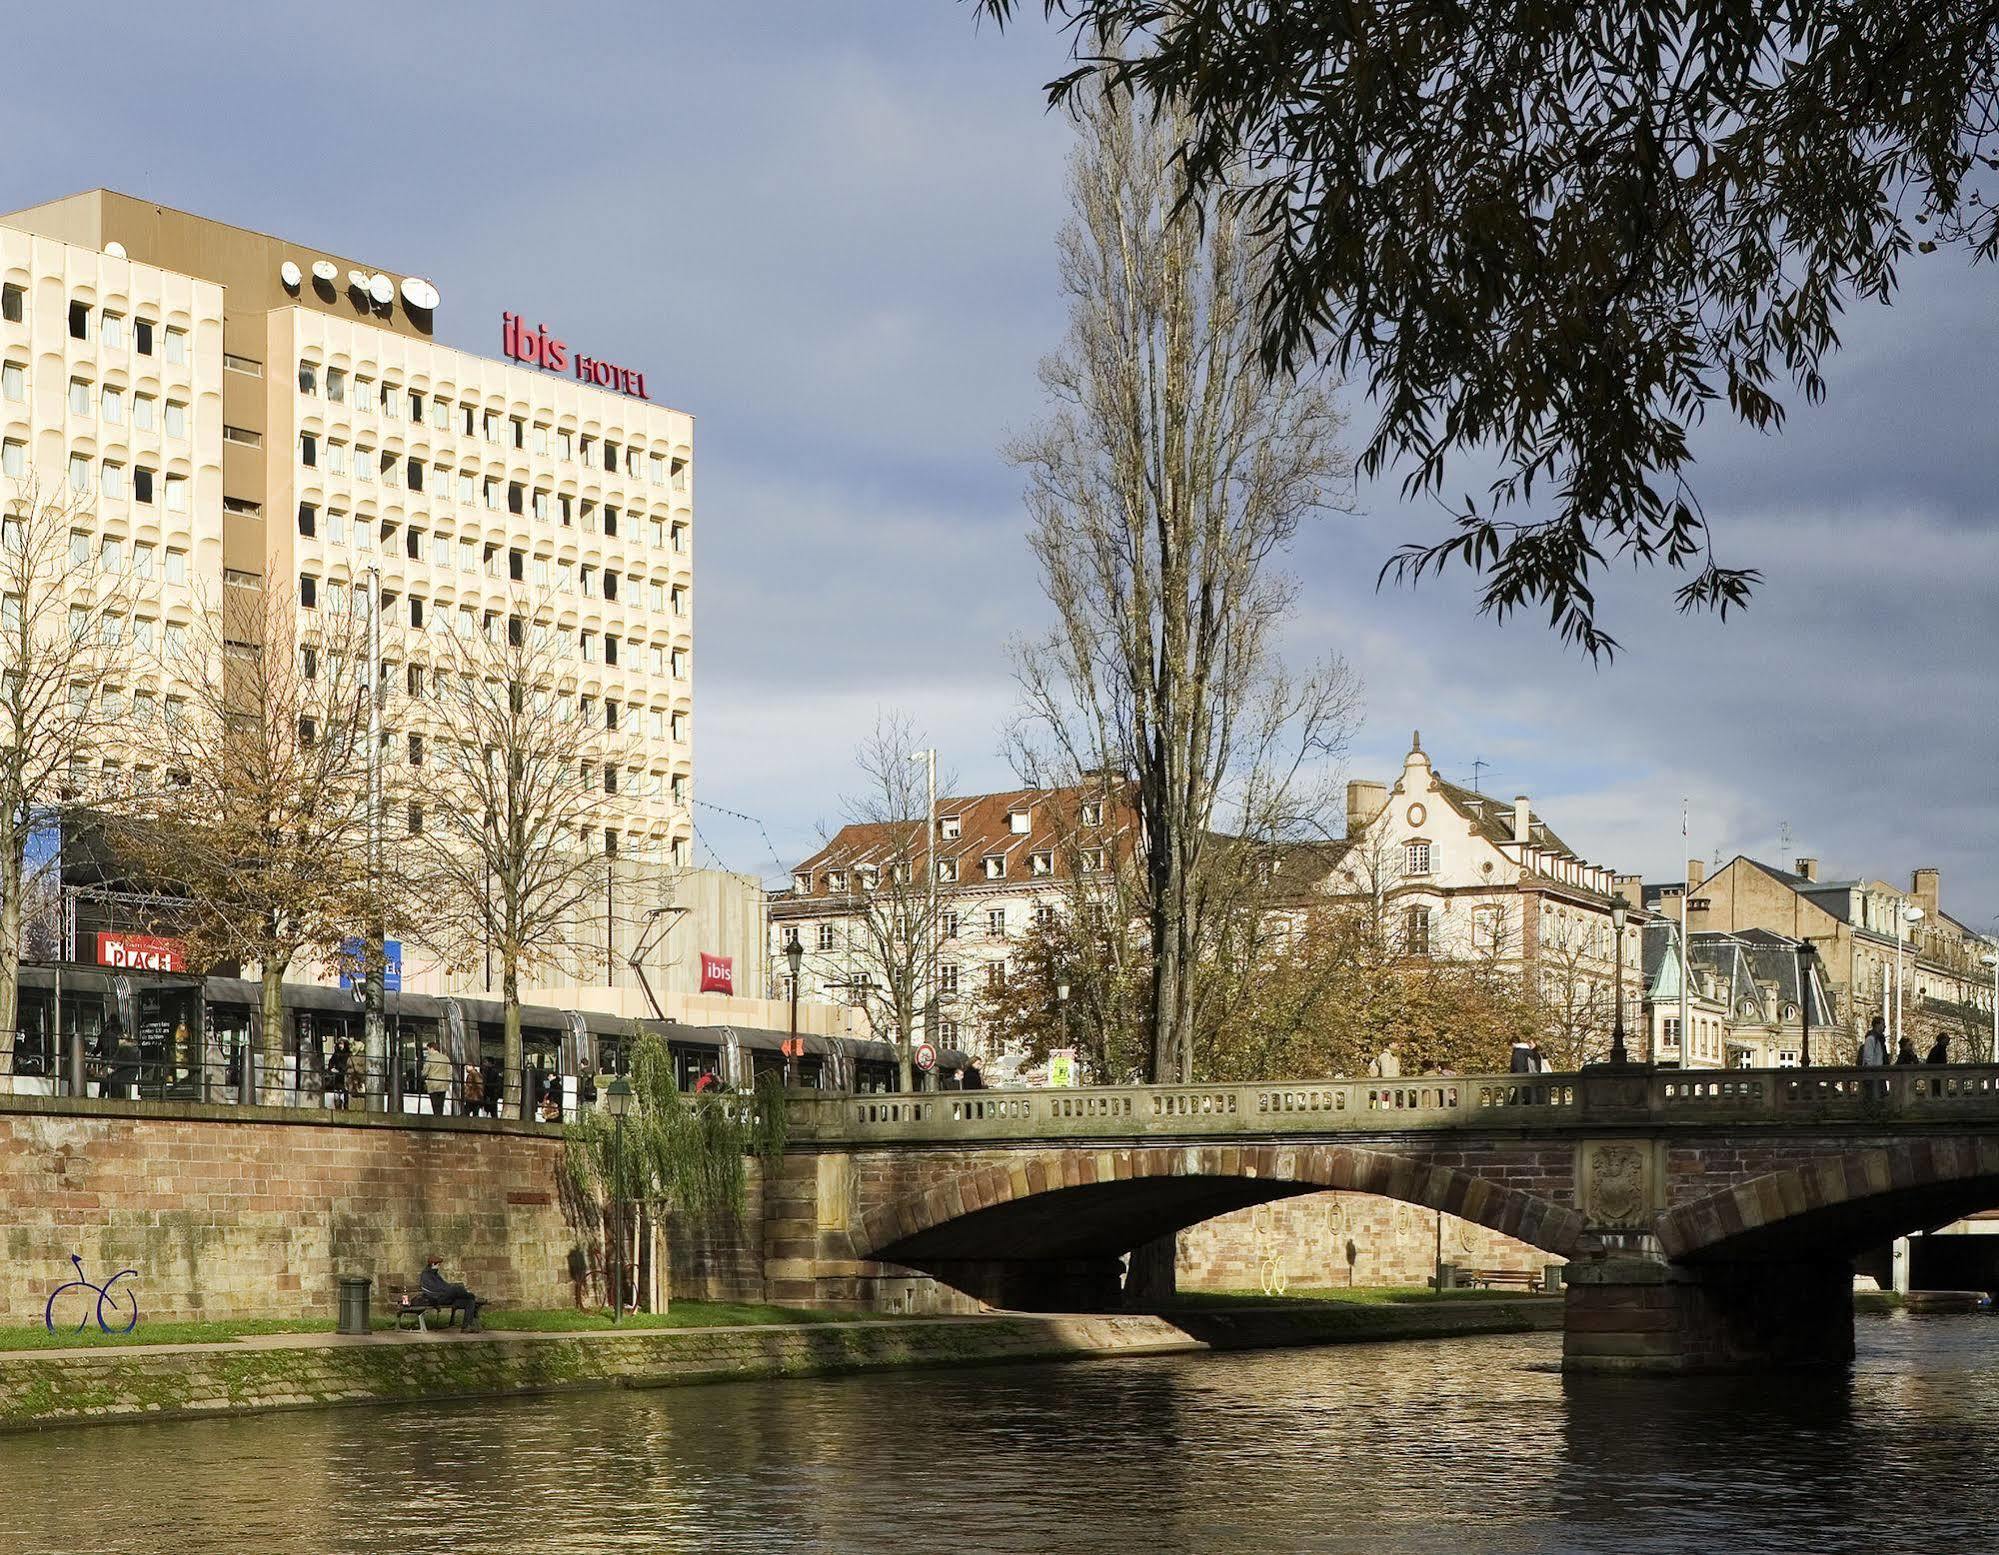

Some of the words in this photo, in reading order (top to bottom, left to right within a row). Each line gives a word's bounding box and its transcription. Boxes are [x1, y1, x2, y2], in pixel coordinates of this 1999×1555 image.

[503, 311, 568, 372] ibis
[575, 353, 650, 400] HOTEL
[708, 962, 732, 981] ibis
